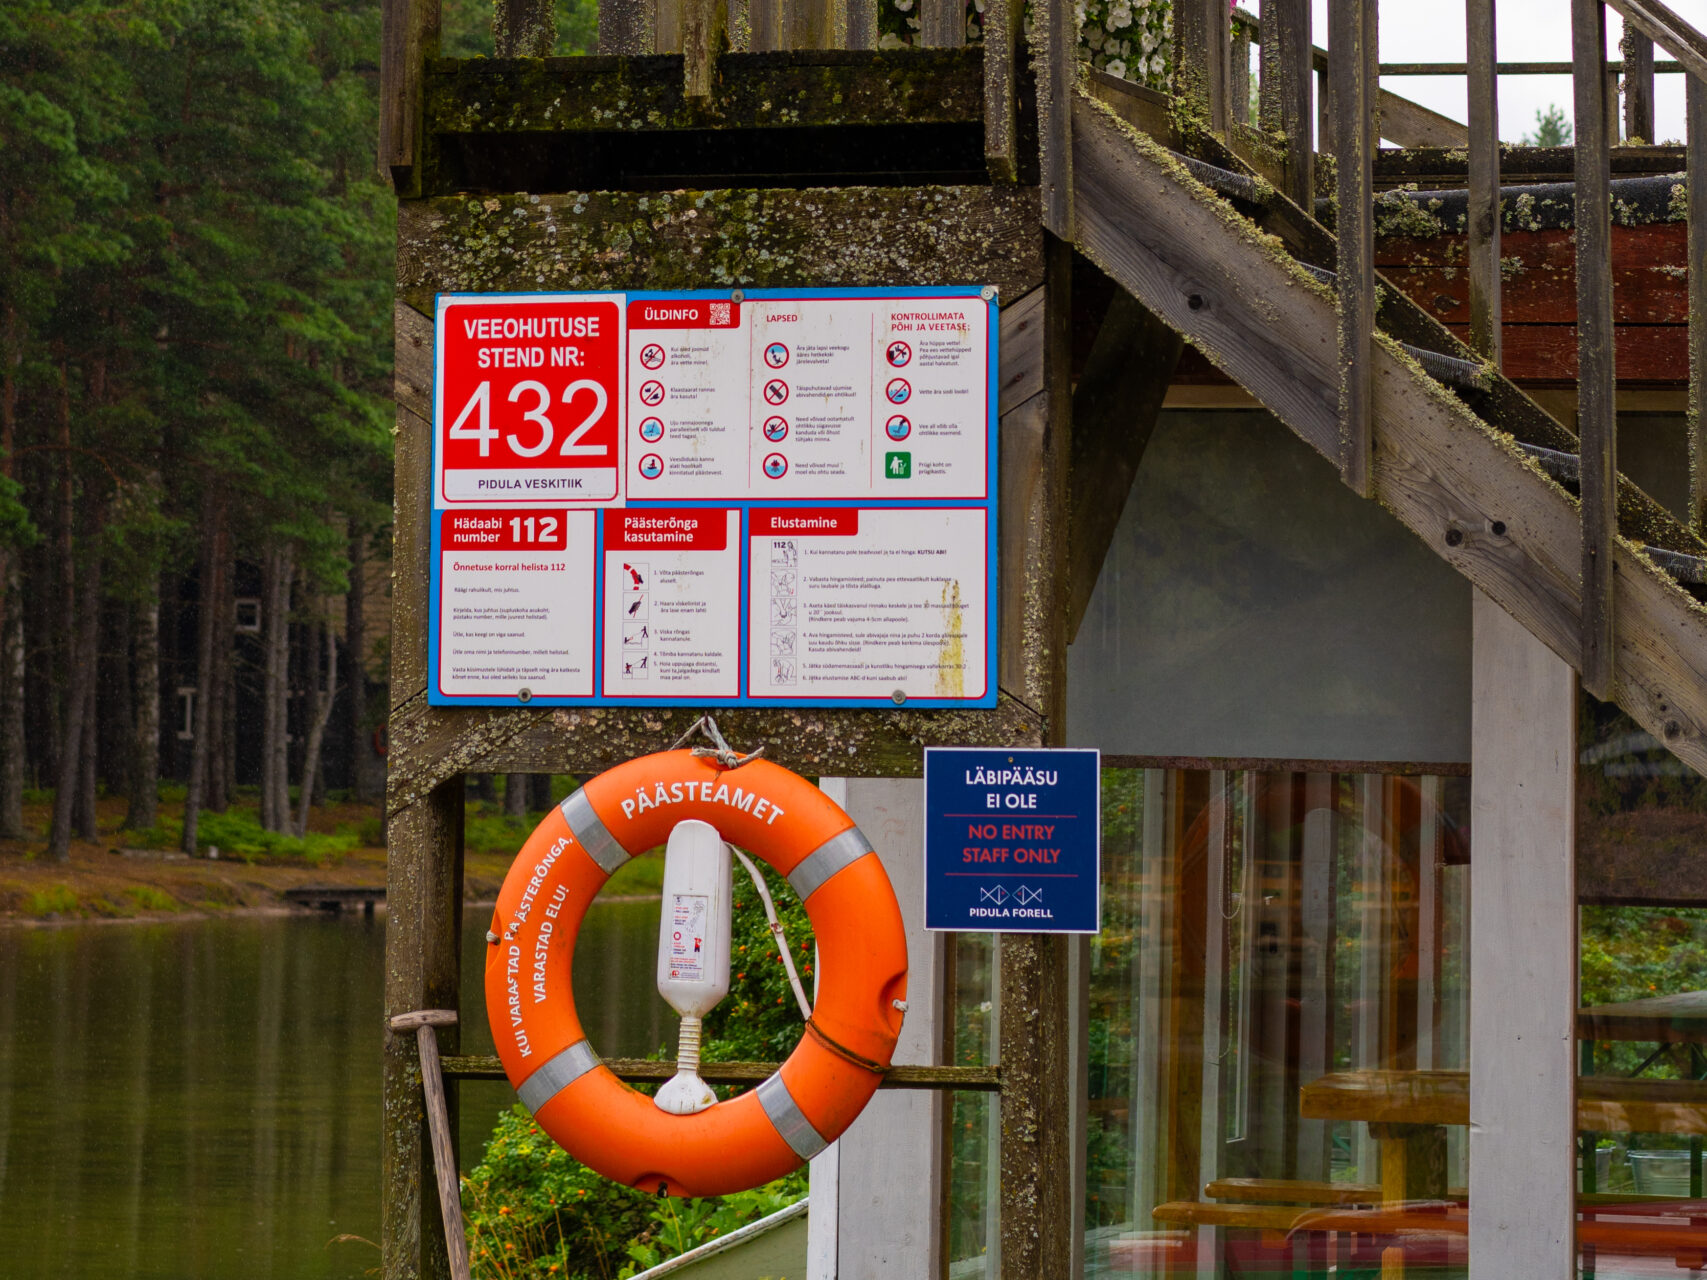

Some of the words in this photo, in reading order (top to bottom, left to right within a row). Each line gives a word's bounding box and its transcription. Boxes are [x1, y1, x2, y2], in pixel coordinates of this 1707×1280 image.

[644, 307, 698, 320] ÜLDINFO
[766, 314, 797, 323] LAPSED
[891, 312, 964, 321] KONTROLLIMATA
[464, 317, 600, 339] VEEOHUTUSE
[891, 322, 912, 331] PÕHI
[916, 323, 926, 331] JA
[478, 347, 544, 368] STEND
[551, 347, 585, 368] NR:
[449, 379, 608, 457] 432
[478, 478, 521, 489] PIDULA
[525, 478, 582, 489] VESKITIIK
[454, 518, 502, 529] Hädaabi
[624, 517, 698, 531] Päästerõnga
[770, 516, 838, 528] Elustamine
[454, 531, 500, 543] number
[509, 517, 558, 543] 112
[624, 531, 694, 542] kasutamine
[453, 562, 493, 571] Õnnetuse
[495, 563, 519, 571] korral
[521, 563, 548, 571] helista
[551, 563, 566, 571] 112
[966, 766, 1058, 786] LÄBIPÄÄSU
[621, 781, 784, 825] PÄÄSTEAMET
[986, 793, 1000, 809] EI
[1005, 793, 1037, 809] OLE
[969, 824, 997, 840] NO
[1002, 824, 1055, 840] ENTRY
[962, 848, 1009, 863] STAFF
[1014, 848, 1061, 863] ONLY
[969, 908, 1010, 918] PIDULA
[1013, 908, 1053, 918] FORELL
[534, 921, 553, 1004] VARASTAD
[545, 884, 570, 919] ELU!
[507, 945, 523, 1028] VARASTAD
[515, 1029, 532, 1058] KUI
